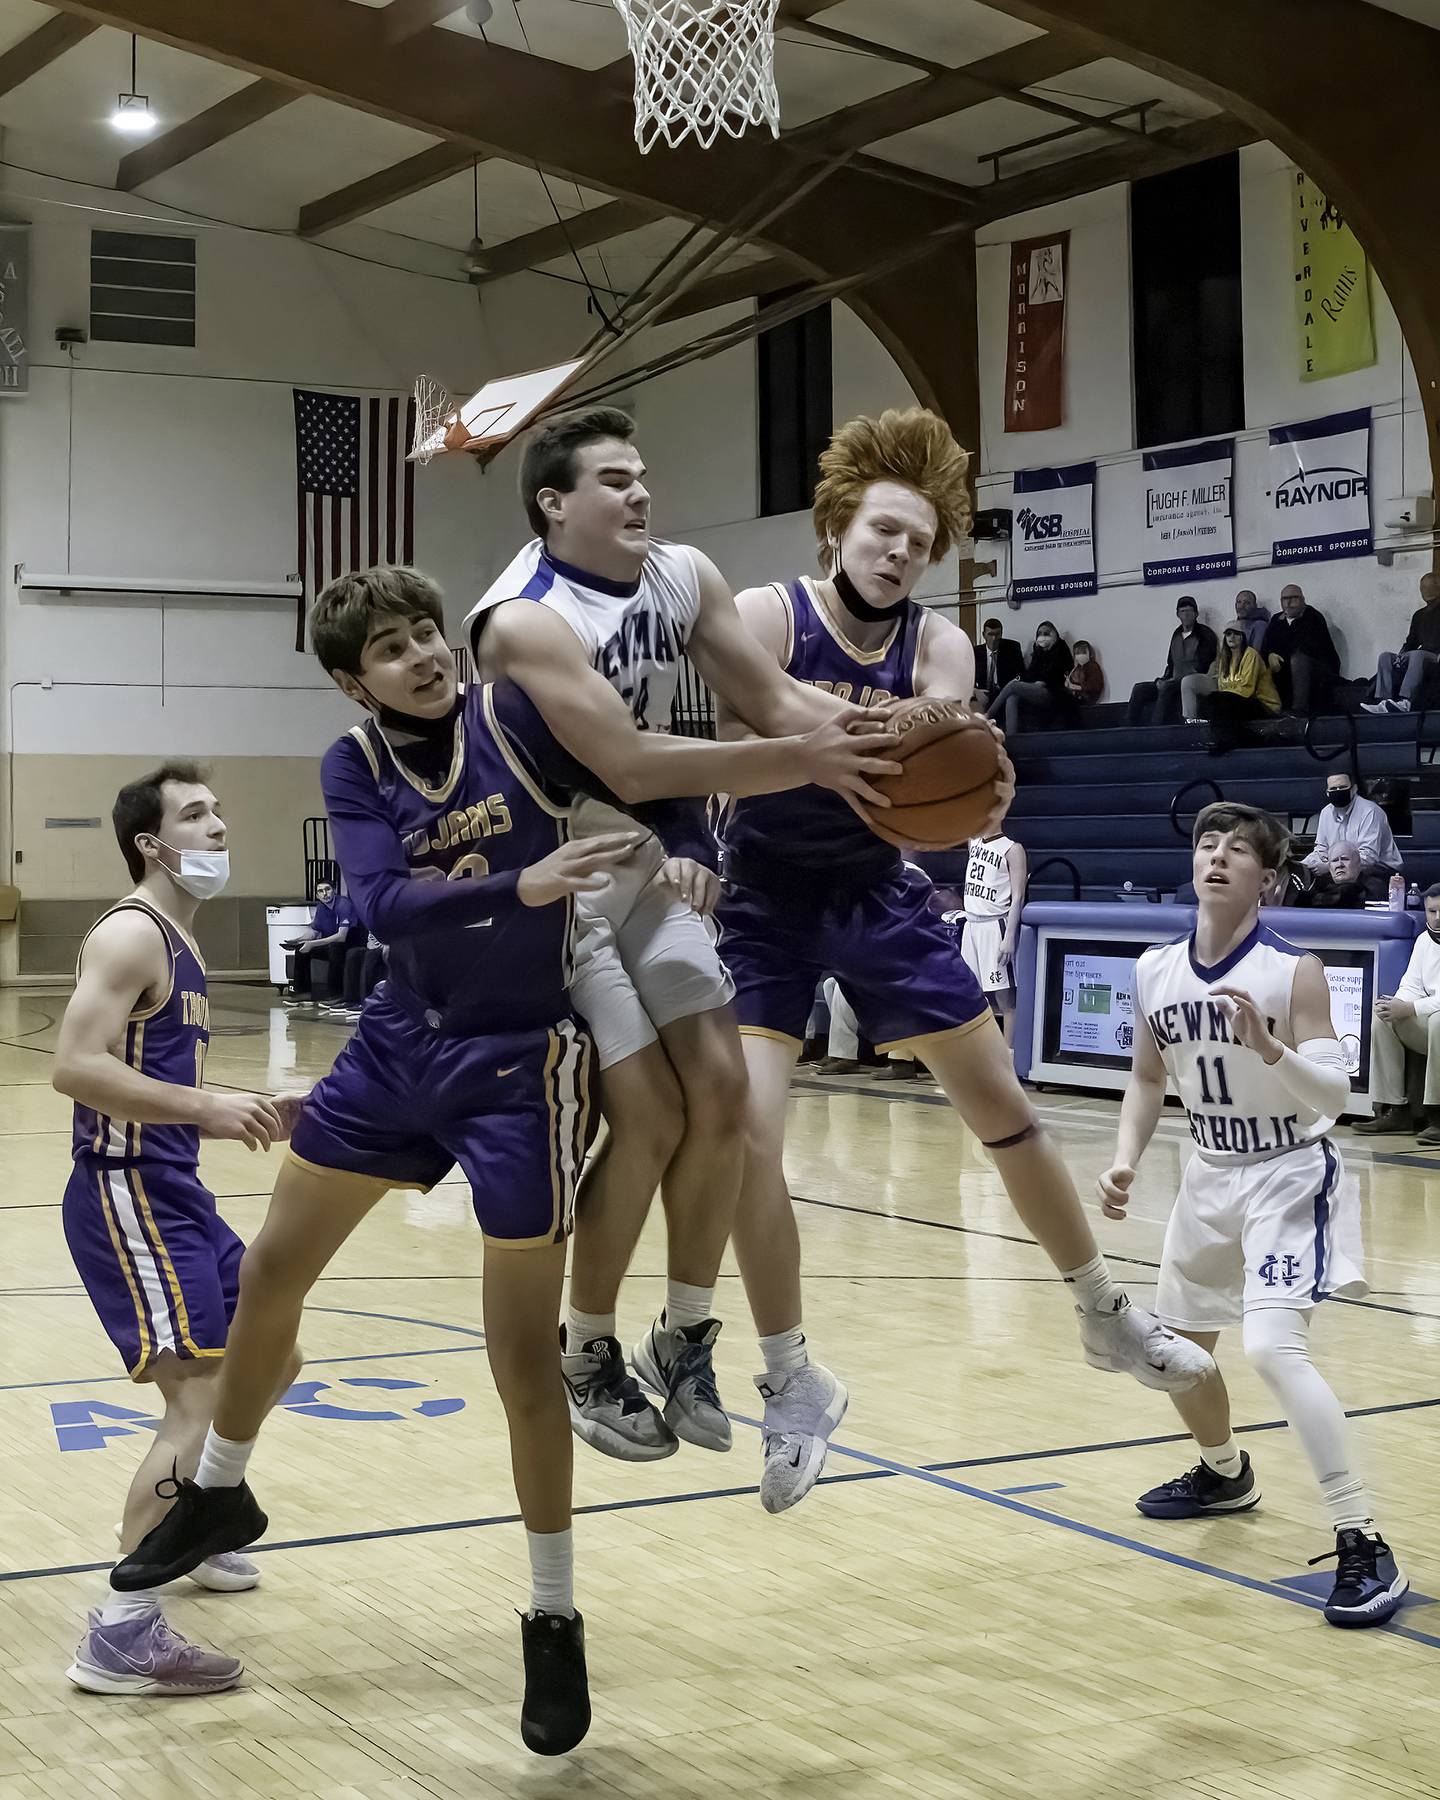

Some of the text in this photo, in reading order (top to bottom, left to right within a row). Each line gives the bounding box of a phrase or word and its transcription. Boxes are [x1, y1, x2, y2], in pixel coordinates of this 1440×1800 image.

[1012, 262, 1027, 414] MORRISON
[1150, 490, 1181, 511] HUGH
[1191, 483, 1227, 505] MILLER
[1275, 476, 1369, 509] RAYNOR
[1024, 513, 1063, 541] KSB
[1275, 538, 1368, 557] CORPORATE SPONSOR
[1146, 560, 1232, 577] CORPORATE SPONSOR
[1015, 580, 1094, 594] CORPORATE SPONSOR
[969, 861, 987, 882] 20
[1148, 1000, 1277, 1051] NEWM
[1196, 1055, 1234, 1106] 11
